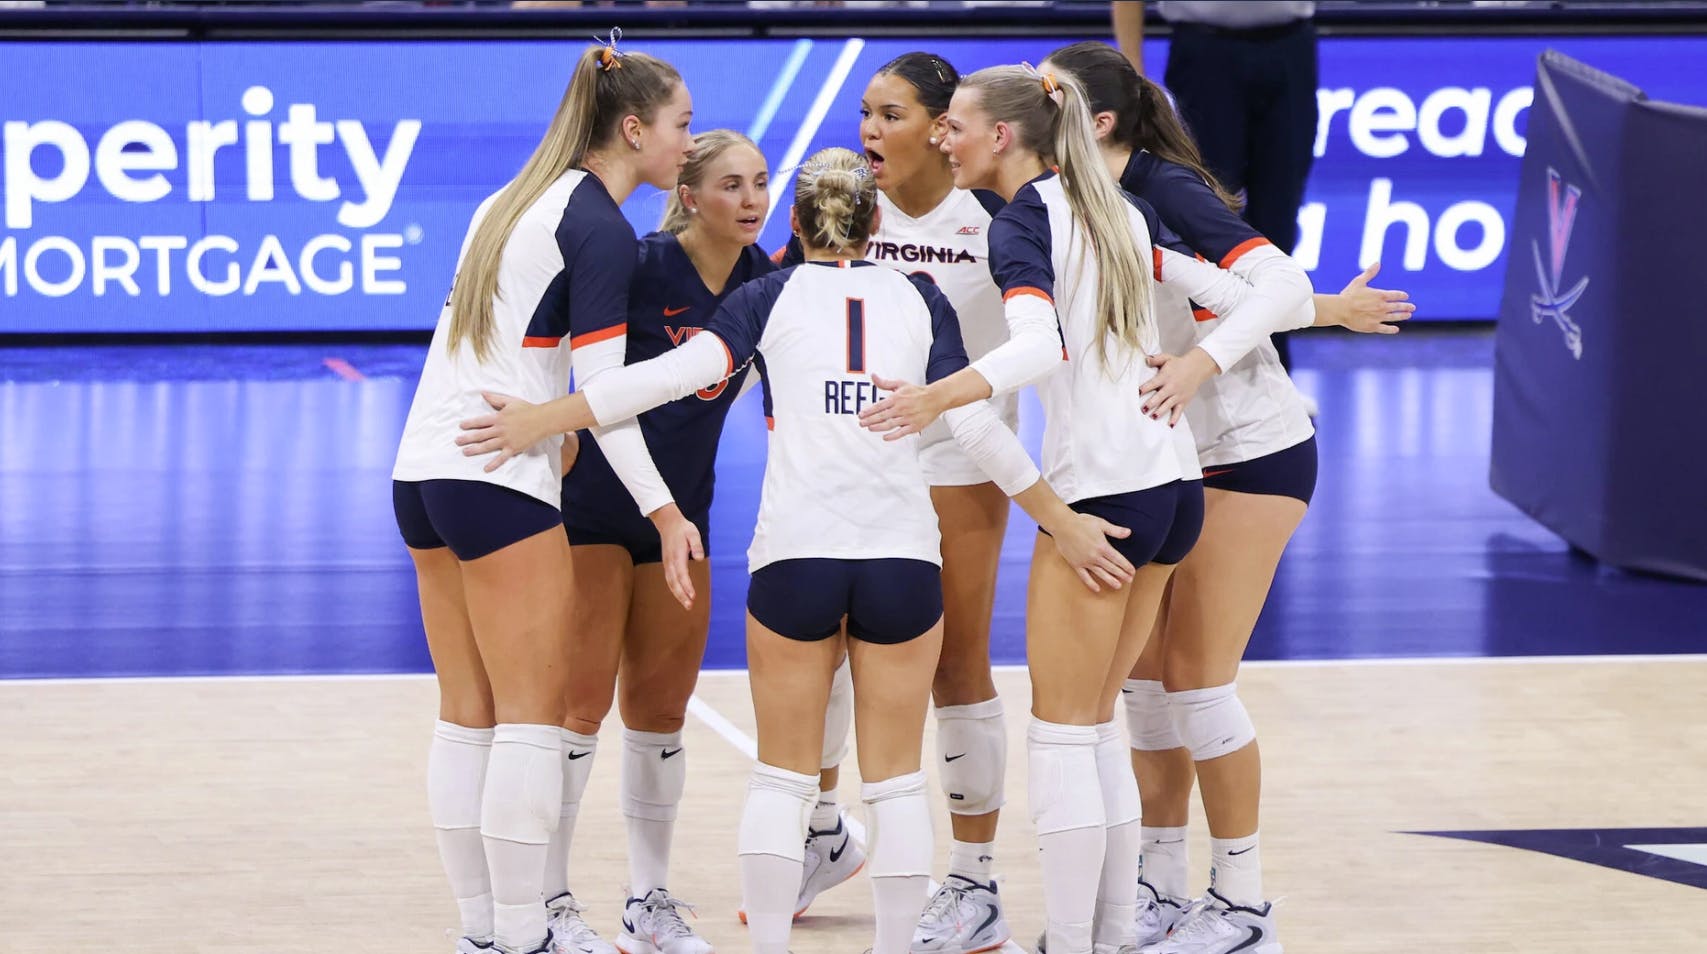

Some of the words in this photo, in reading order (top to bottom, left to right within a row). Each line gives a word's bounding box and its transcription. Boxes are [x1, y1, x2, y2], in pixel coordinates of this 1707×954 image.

[4, 86, 422, 229] perity
[957, 226, 980, 235] ACC
[846, 297, 866, 374] 1
